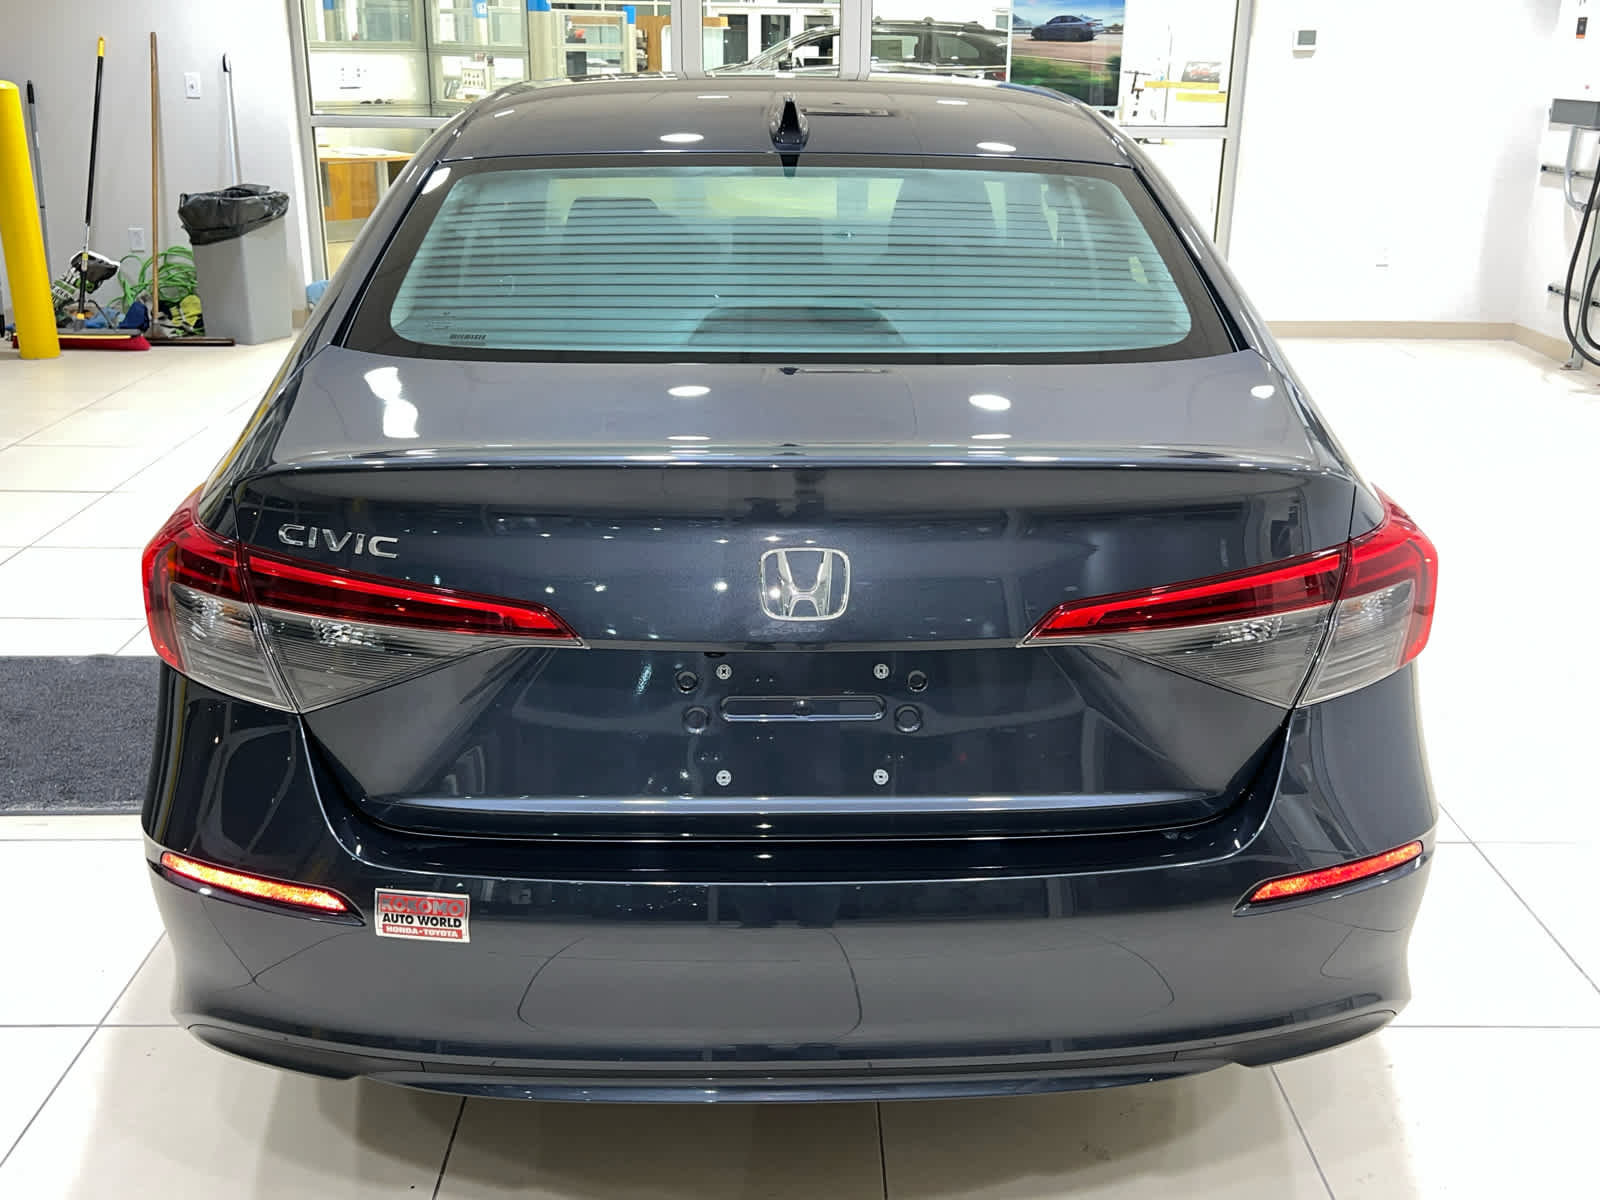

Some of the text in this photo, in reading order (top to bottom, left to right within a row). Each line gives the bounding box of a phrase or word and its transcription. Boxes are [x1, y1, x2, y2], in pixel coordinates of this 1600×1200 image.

[278, 523, 398, 558] CIVIC
[381, 896, 462, 916] KOKOMO
[382, 913, 462, 928] AUTO WORLD
